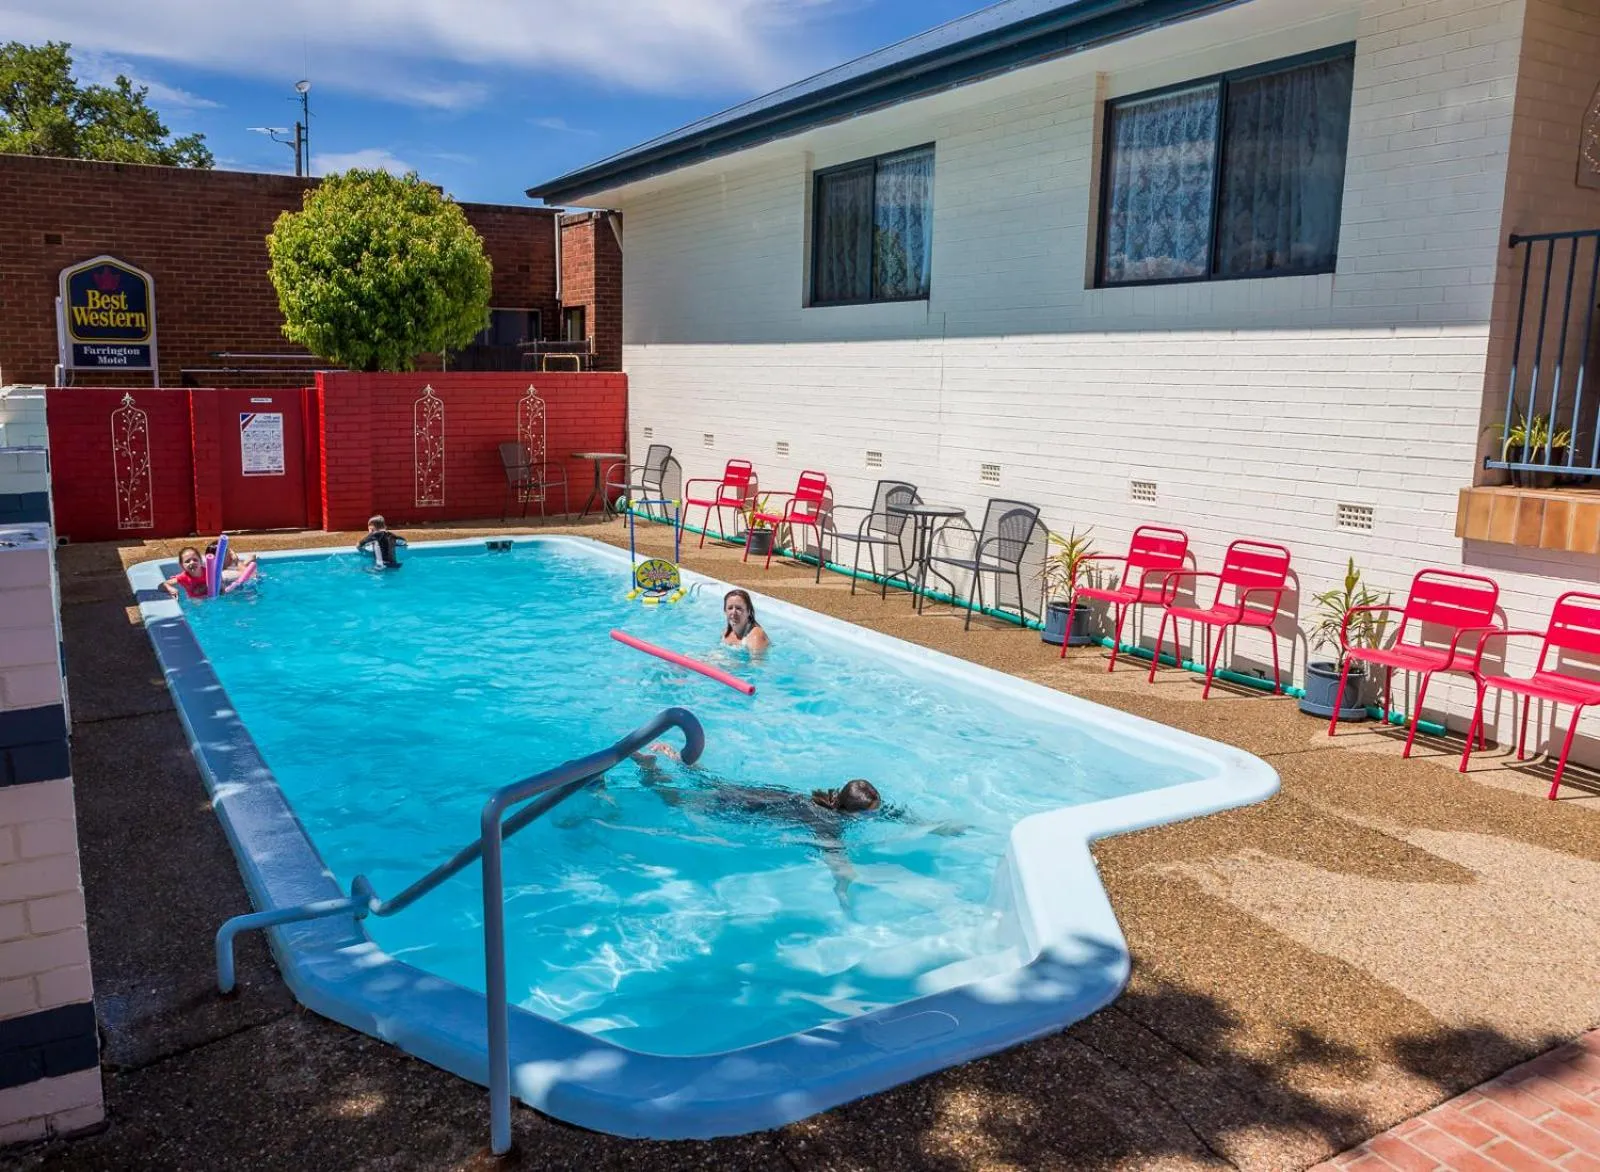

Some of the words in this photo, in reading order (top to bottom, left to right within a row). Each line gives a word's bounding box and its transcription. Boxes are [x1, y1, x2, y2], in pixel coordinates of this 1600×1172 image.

[87, 289, 128, 310] Best
[72, 307, 147, 328] Western
[83, 346, 140, 356] Farrington
[98, 356, 127, 365] Motel
